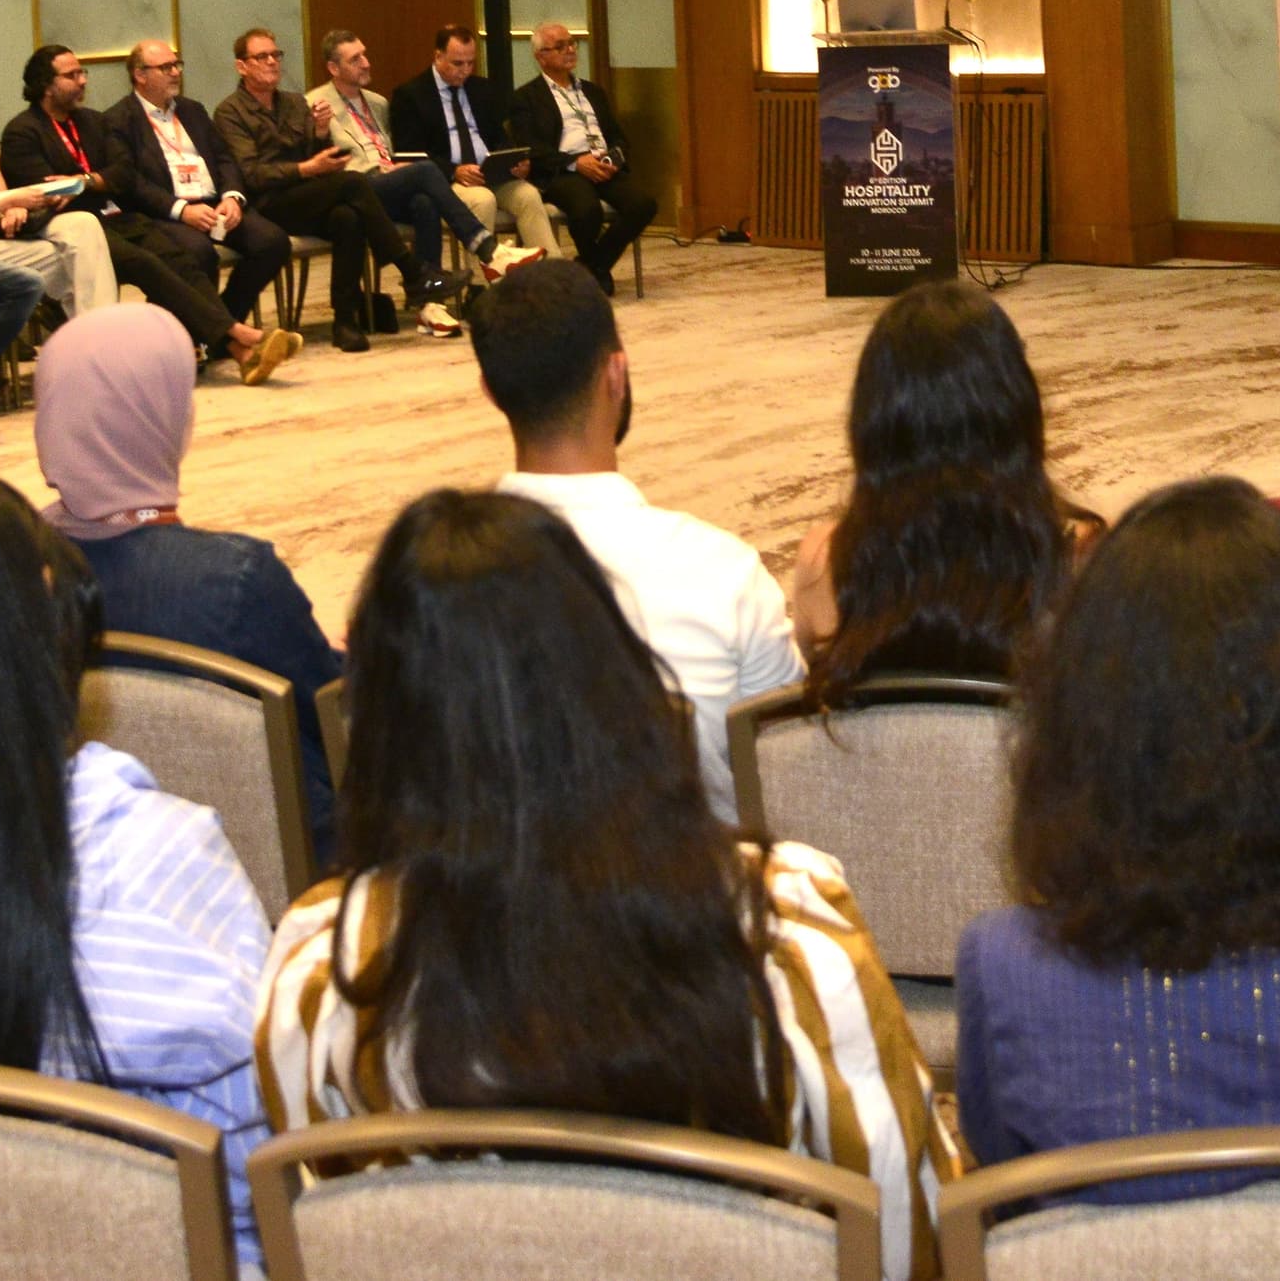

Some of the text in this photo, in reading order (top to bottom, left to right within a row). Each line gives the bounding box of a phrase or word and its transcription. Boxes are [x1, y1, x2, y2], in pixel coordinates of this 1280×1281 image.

[844, 185, 931, 197] HOSPITALITY
[843, 197, 934, 206] INNOVATION SUMMIT
